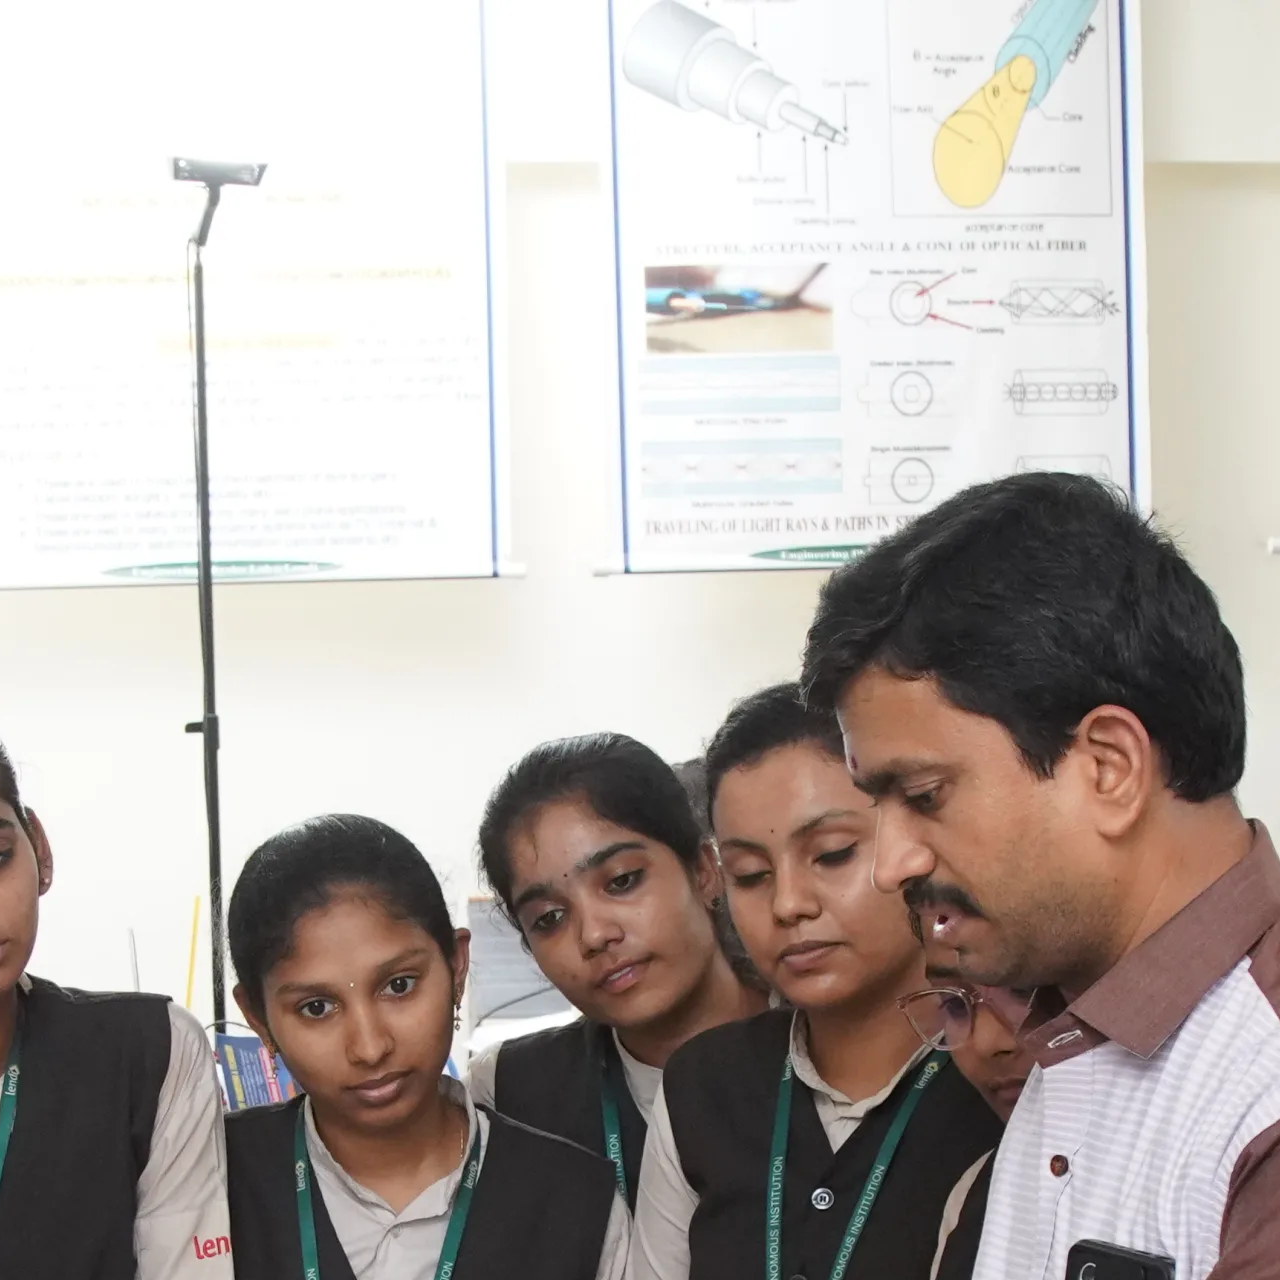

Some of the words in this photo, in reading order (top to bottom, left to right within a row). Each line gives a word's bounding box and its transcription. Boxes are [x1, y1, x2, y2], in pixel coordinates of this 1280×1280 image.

[770, 1157, 784, 1226] INSTITUTION
[850, 1165, 885, 1234] INSTITUTION
[193, 1234, 230, 1260] len
